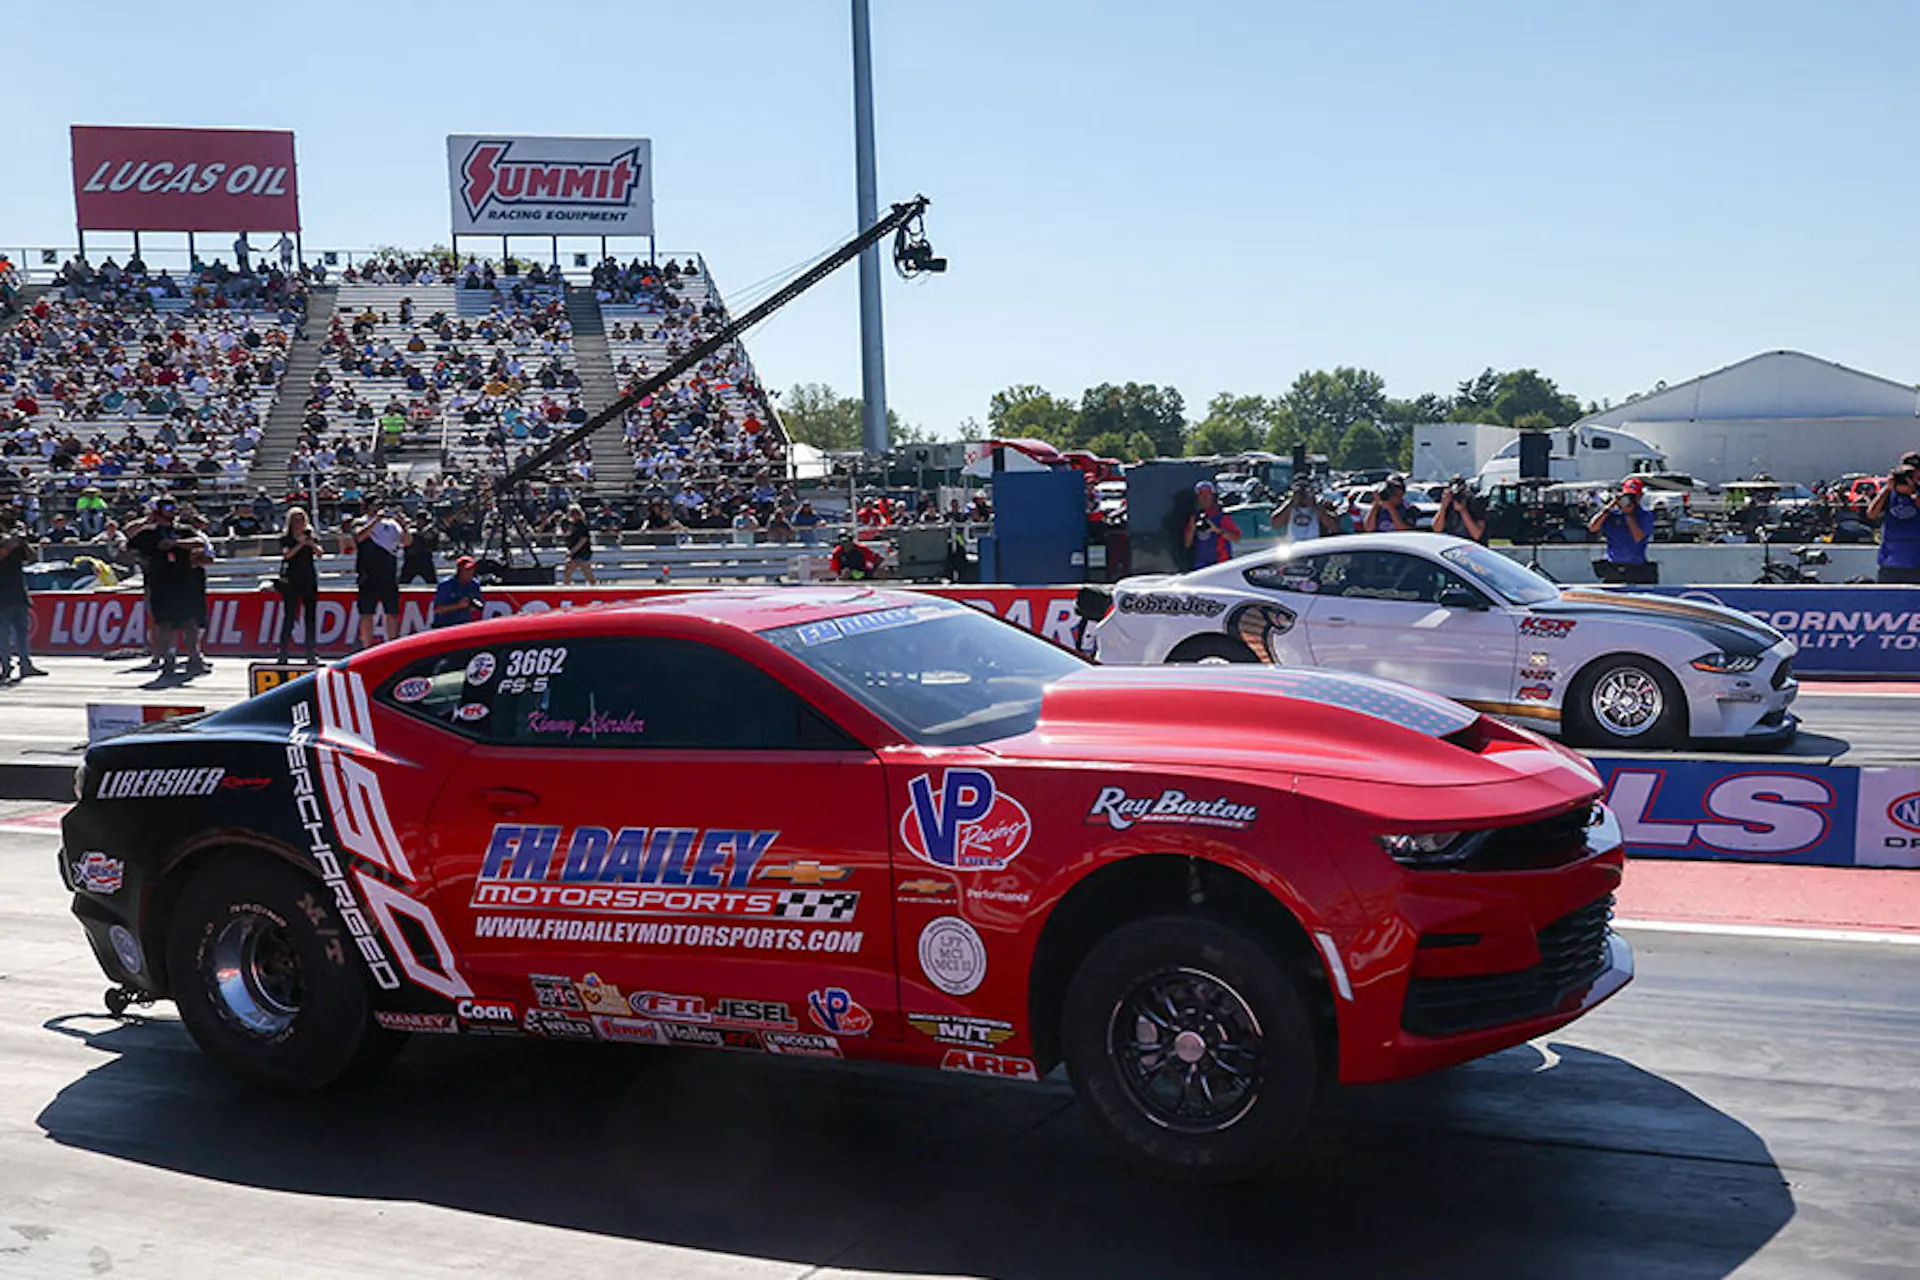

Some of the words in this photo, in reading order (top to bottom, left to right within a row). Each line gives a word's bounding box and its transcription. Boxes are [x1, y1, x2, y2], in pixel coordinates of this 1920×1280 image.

[83, 161, 226, 194] LUCAS
[225, 164, 288, 195] OIL
[488, 209, 542, 221] RACING
[546, 210, 628, 222] EQUIPMENT
[50, 599, 149, 646] LUCA
[203, 599, 243, 646] IL
[1878, 634, 1920, 649] TO
[506, 647, 568, 677] 3662
[97, 767, 226, 800] LIBERSHER
[908, 768, 995, 868] VP
[1091, 786, 1153, 830] Ray
[1153, 789, 1258, 821] Barton
[961, 820, 1027, 855] Racing
[481, 823, 563, 882] FH
[563, 825, 779, 888] DAILEY
[477, 884, 772, 914] MOTORSPORTS
[475, 916, 864, 953] WWW.FHDAILEYMOTORSPORTS.COM
[457, 1000, 514, 1021] Coan
[713, 1000, 798, 1022] JESEL
[809, 988, 852, 1032] VP
[543, 1019, 590, 1034] WELD
[665, 1022, 724, 1046] Holley
[938, 1022, 992, 1041] M/T
[945, 1051, 1033, 1077] ARP
